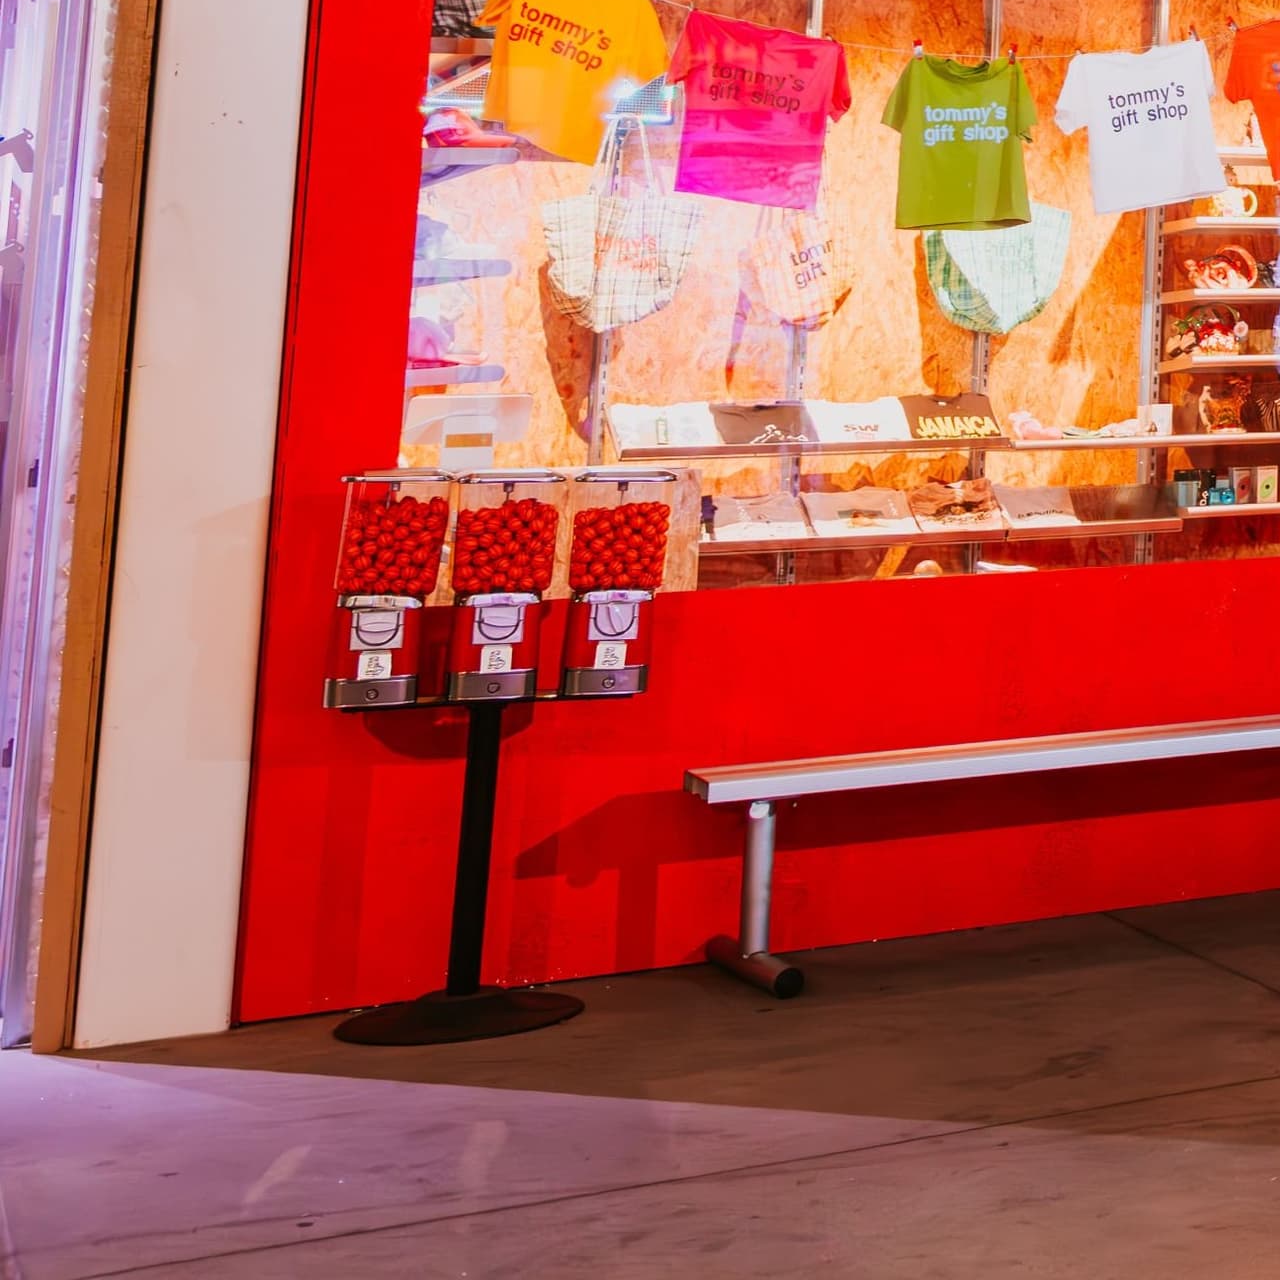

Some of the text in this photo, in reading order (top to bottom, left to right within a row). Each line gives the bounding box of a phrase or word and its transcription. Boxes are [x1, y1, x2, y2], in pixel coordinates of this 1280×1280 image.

[519, 1, 612, 51] tommy's
[508, 23, 603, 72] gift shop
[711, 61, 805, 92] tommy's
[709, 82, 801, 114] gift shop
[1108, 81, 1185, 110] tommy's
[924, 101, 1008, 125] tommy's
[1111, 103, 1189, 133] gift shop
[923, 123, 1009, 146] gift shop
[916, 415, 1000, 437] JAMAICA
